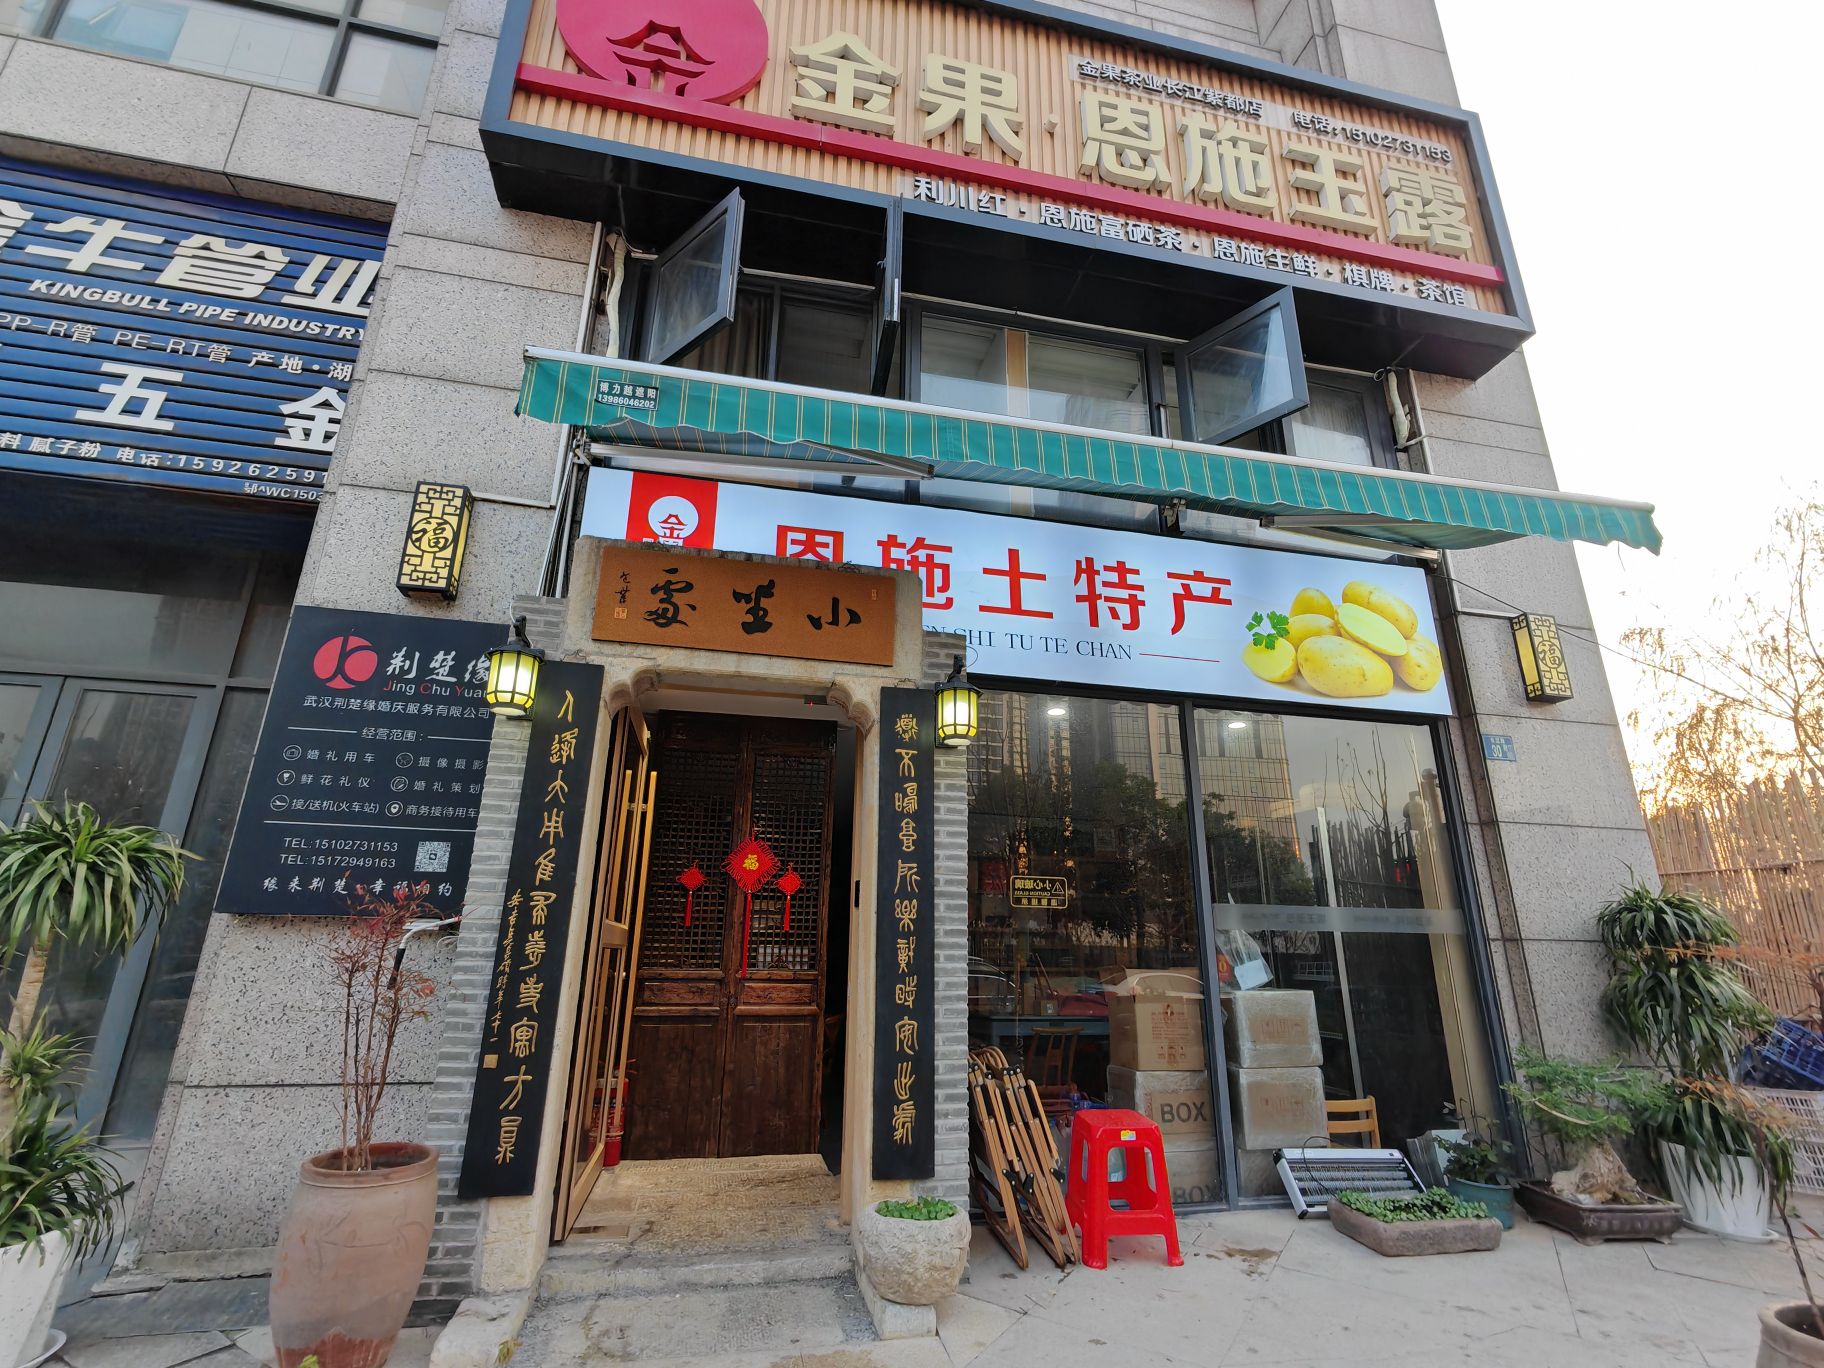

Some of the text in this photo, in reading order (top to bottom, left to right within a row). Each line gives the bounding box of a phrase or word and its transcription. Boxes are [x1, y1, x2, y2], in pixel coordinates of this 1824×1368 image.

[1078, 60, 1263, 117] 金果茶业长江紫都店
[28, 279, 171, 312] KINGBULL
[178, 301, 240, 322] PIPE
[113, 329, 232, 364] PE-RT管
[598, 394, 655, 408] 13986046202
[28, 436, 102, 459] 腻子粉
[1005, 632, 1034, 651] TU
[1040, 636, 1069, 655] TE
[1076, 640, 1133, 660] CHAN
[383, 680, 416, 696] Jing
[420, 682, 450, 696] Chu
[303, 695, 490, 720] 武汉荆楚缘婚庆服务有限公司
[306, 749, 485, 770] 婚礼用车 摄像摄影
[300, 773, 481, 794] 鲜花礼仪 婚礼策划
[405, 804, 478, 818] 商务接待用车
[283, 837, 398, 852] TEL:15102731153
[280, 853, 396, 868] TEL:15172949163
[1161, 1102, 1207, 1123] BOX
